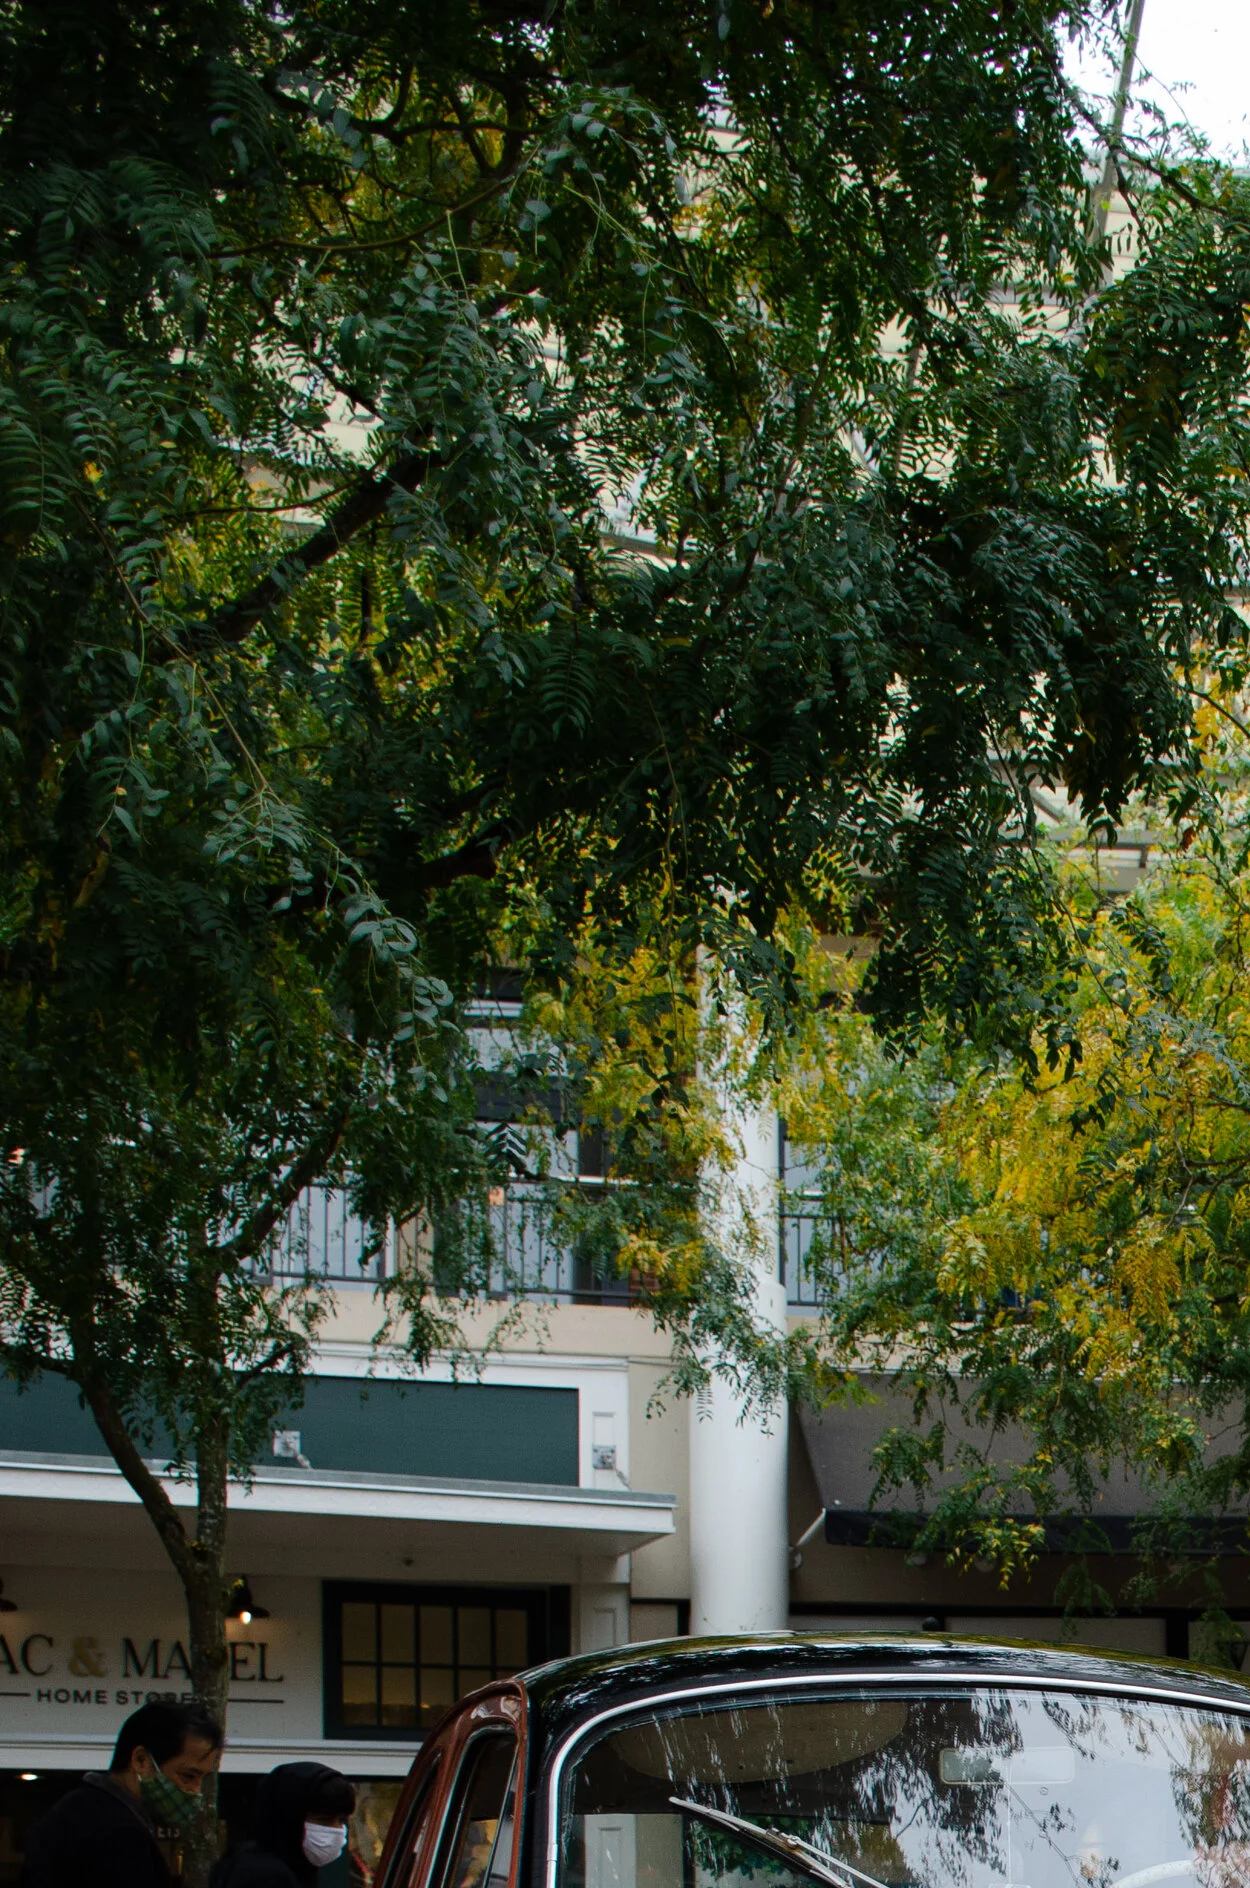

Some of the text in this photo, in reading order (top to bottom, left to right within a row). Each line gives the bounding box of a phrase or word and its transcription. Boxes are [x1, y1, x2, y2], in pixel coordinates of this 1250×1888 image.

[67, 1636, 108, 1678] &
[122, 1637, 284, 1683] MAEL
[37, 1688, 108, 1705] HOME
